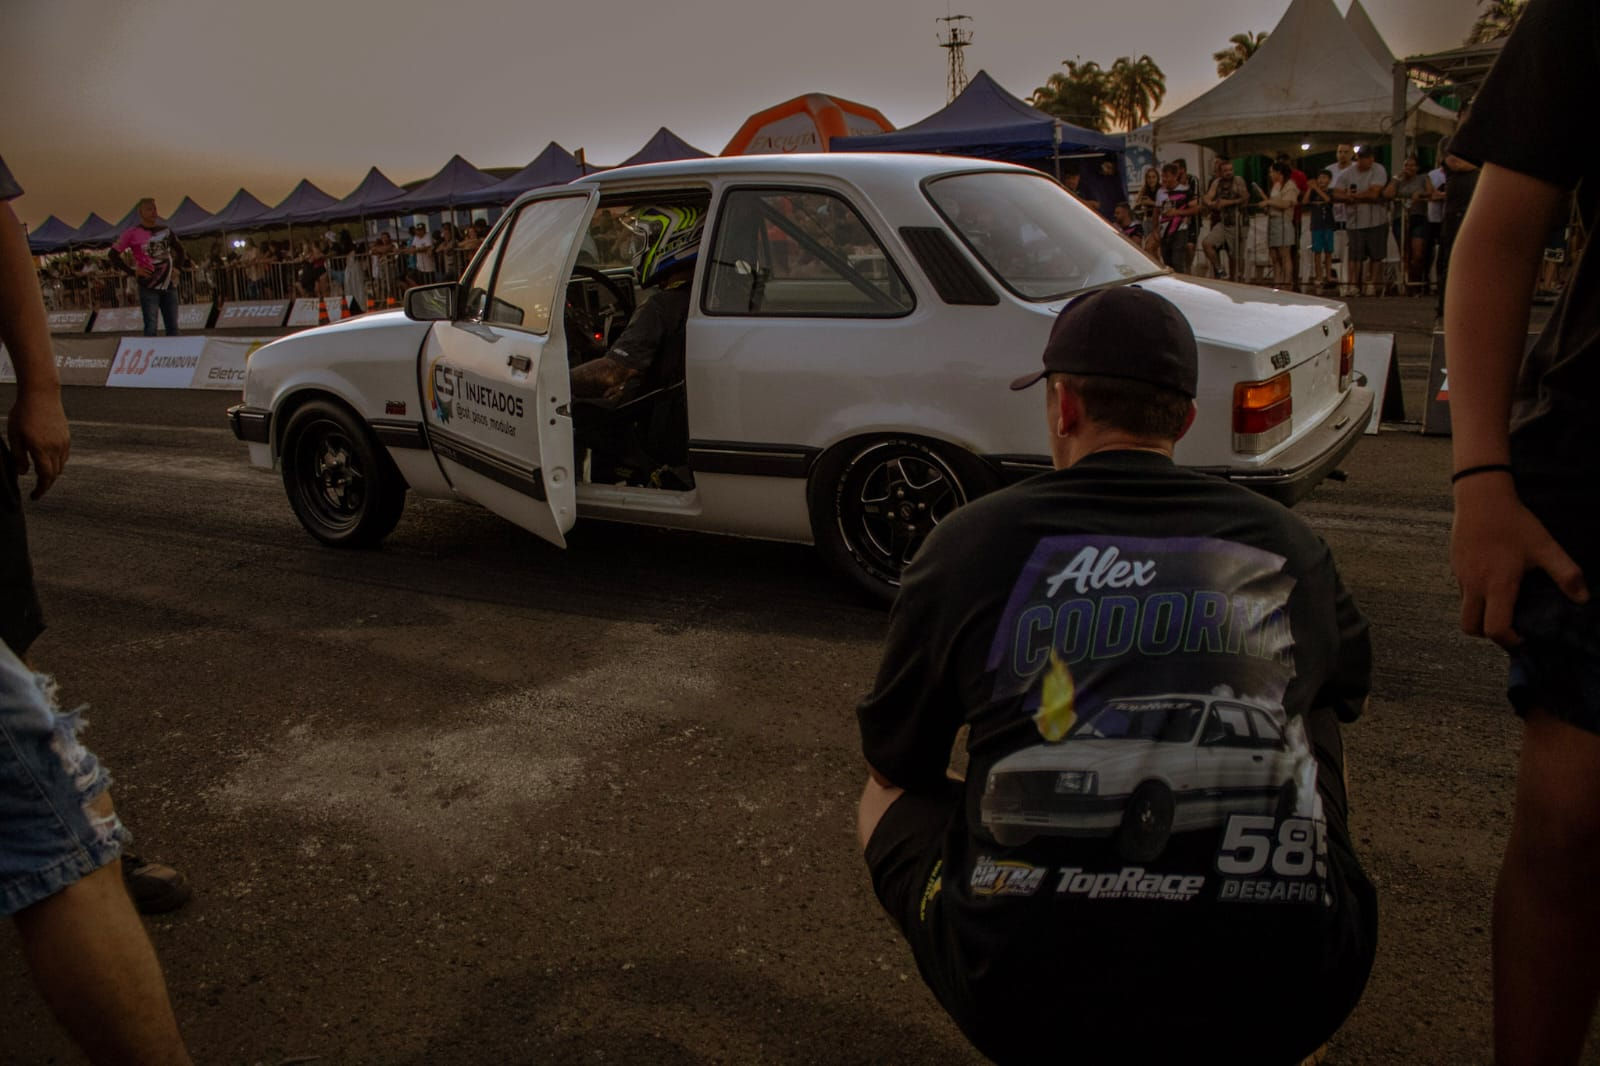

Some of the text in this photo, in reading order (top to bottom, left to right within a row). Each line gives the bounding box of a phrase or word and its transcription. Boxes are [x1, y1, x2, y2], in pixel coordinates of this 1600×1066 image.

[223, 305, 284, 318] STAGE
[465, 381, 524, 418] INJETADOS
[1046, 545, 1156, 598] Alex
[1055, 866, 1206, 899] TopRace
[1218, 879, 1318, 904] DESAFIO
